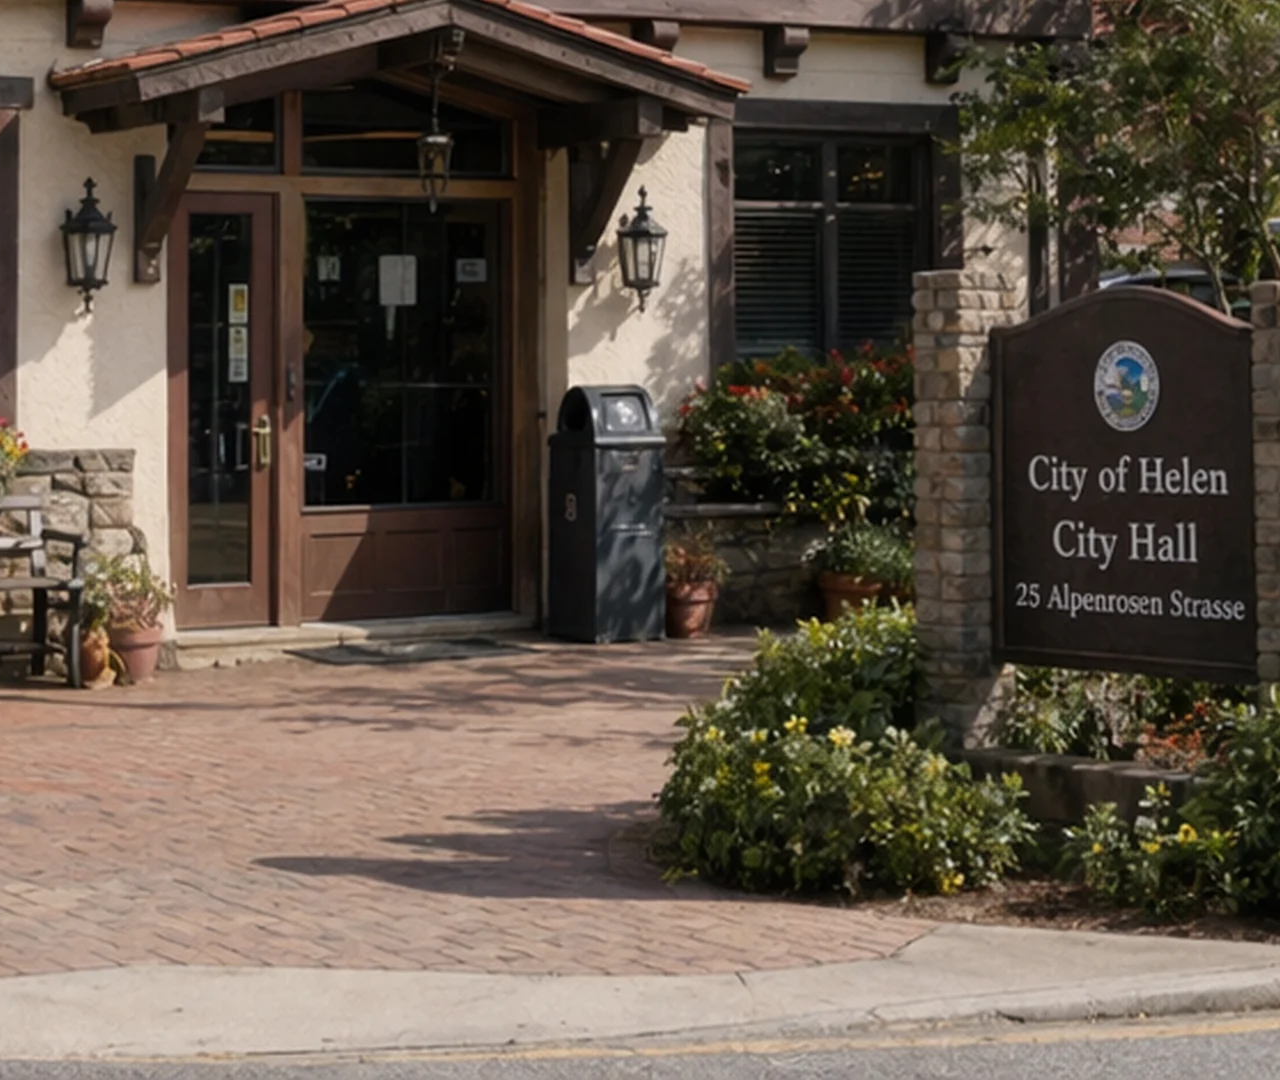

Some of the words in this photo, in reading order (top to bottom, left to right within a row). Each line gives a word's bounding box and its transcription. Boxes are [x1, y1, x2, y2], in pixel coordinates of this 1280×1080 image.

[1028, 455, 1088, 502] City
[1098, 455, 1131, 493] of
[1139, 456, 1228, 495] Helen
[1052, 520, 1118, 571] City
[1129, 522, 1198, 563] Hall
[1015, 582, 1040, 608] 25
[1047, 583, 1163, 618] Alpenrosen
[1169, 590, 1245, 621] Strasse
